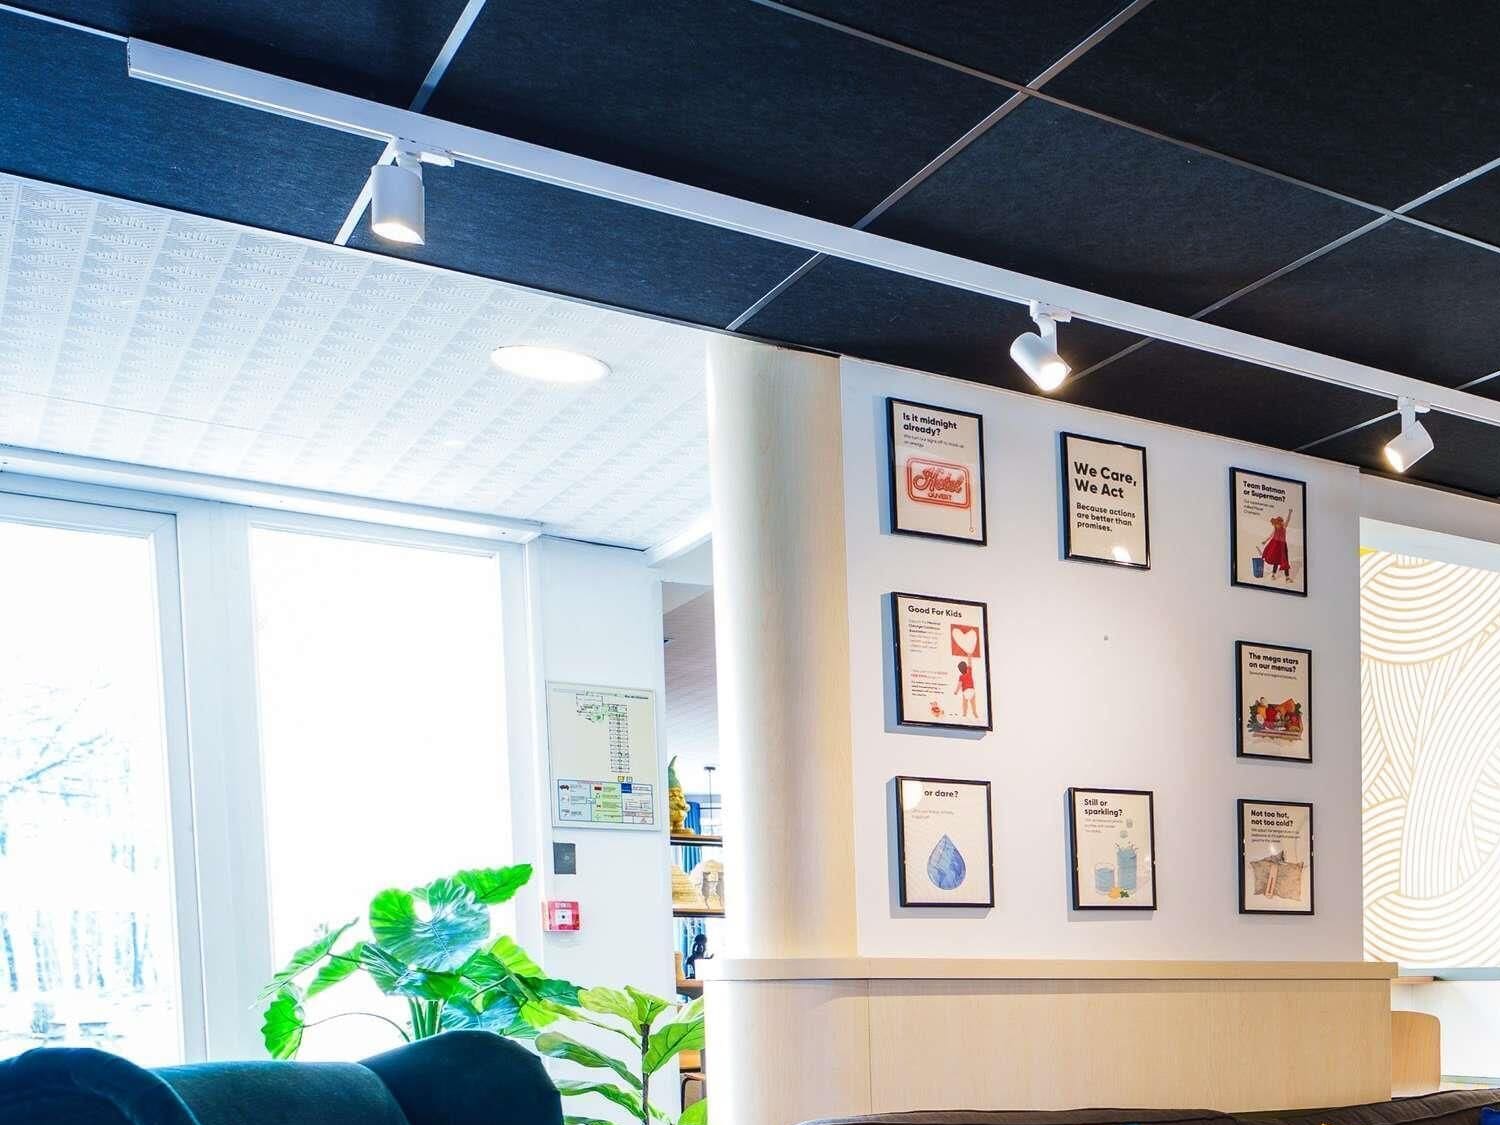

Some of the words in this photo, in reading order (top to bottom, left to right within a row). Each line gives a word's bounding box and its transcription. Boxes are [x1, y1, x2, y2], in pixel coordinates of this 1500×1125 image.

[903, 412, 910, 421] Is
[911, 413, 919, 422] it
[920, 415, 957, 430] midnight
[903, 423, 941, 436] already?
[1074, 461, 1097, 477] We
[1100, 466, 1137, 487] Care,
[1074, 478, 1098, 494] We
[1101, 483, 1124, 499] Act
[1243, 480, 1260, 490] Team
[1261, 484, 1286, 495] Batman
[1251, 490, 1286, 503] Superman?
[1076, 502, 1108, 513] Because
[1109, 508, 1136, 518] actions
[1076, 512, 1090, 520] are
[1091, 512, 1114, 523] better
[1115, 517, 1132, 527] than
[1077, 521, 1113, 532] promises.
[907, 605, 930, 615] Good
[931, 607, 944, 616] For
[945, 609, 962, 618] Kids
[1249, 652, 1261, 660] The
[1262, 655, 1281, 664] mega
[1282, 655, 1299, 665] stars
[1271, 665, 1296, 673] menus?
[934, 789, 959, 798] dare?
[1084, 798, 1099, 806] Still
[1084, 808, 1123, 817] sparkling?
[1251, 809, 1263, 817] Not
[1264, 810, 1275, 818] too
[1276, 810, 1289, 819] hot,
[1251, 818, 1263, 826] not
